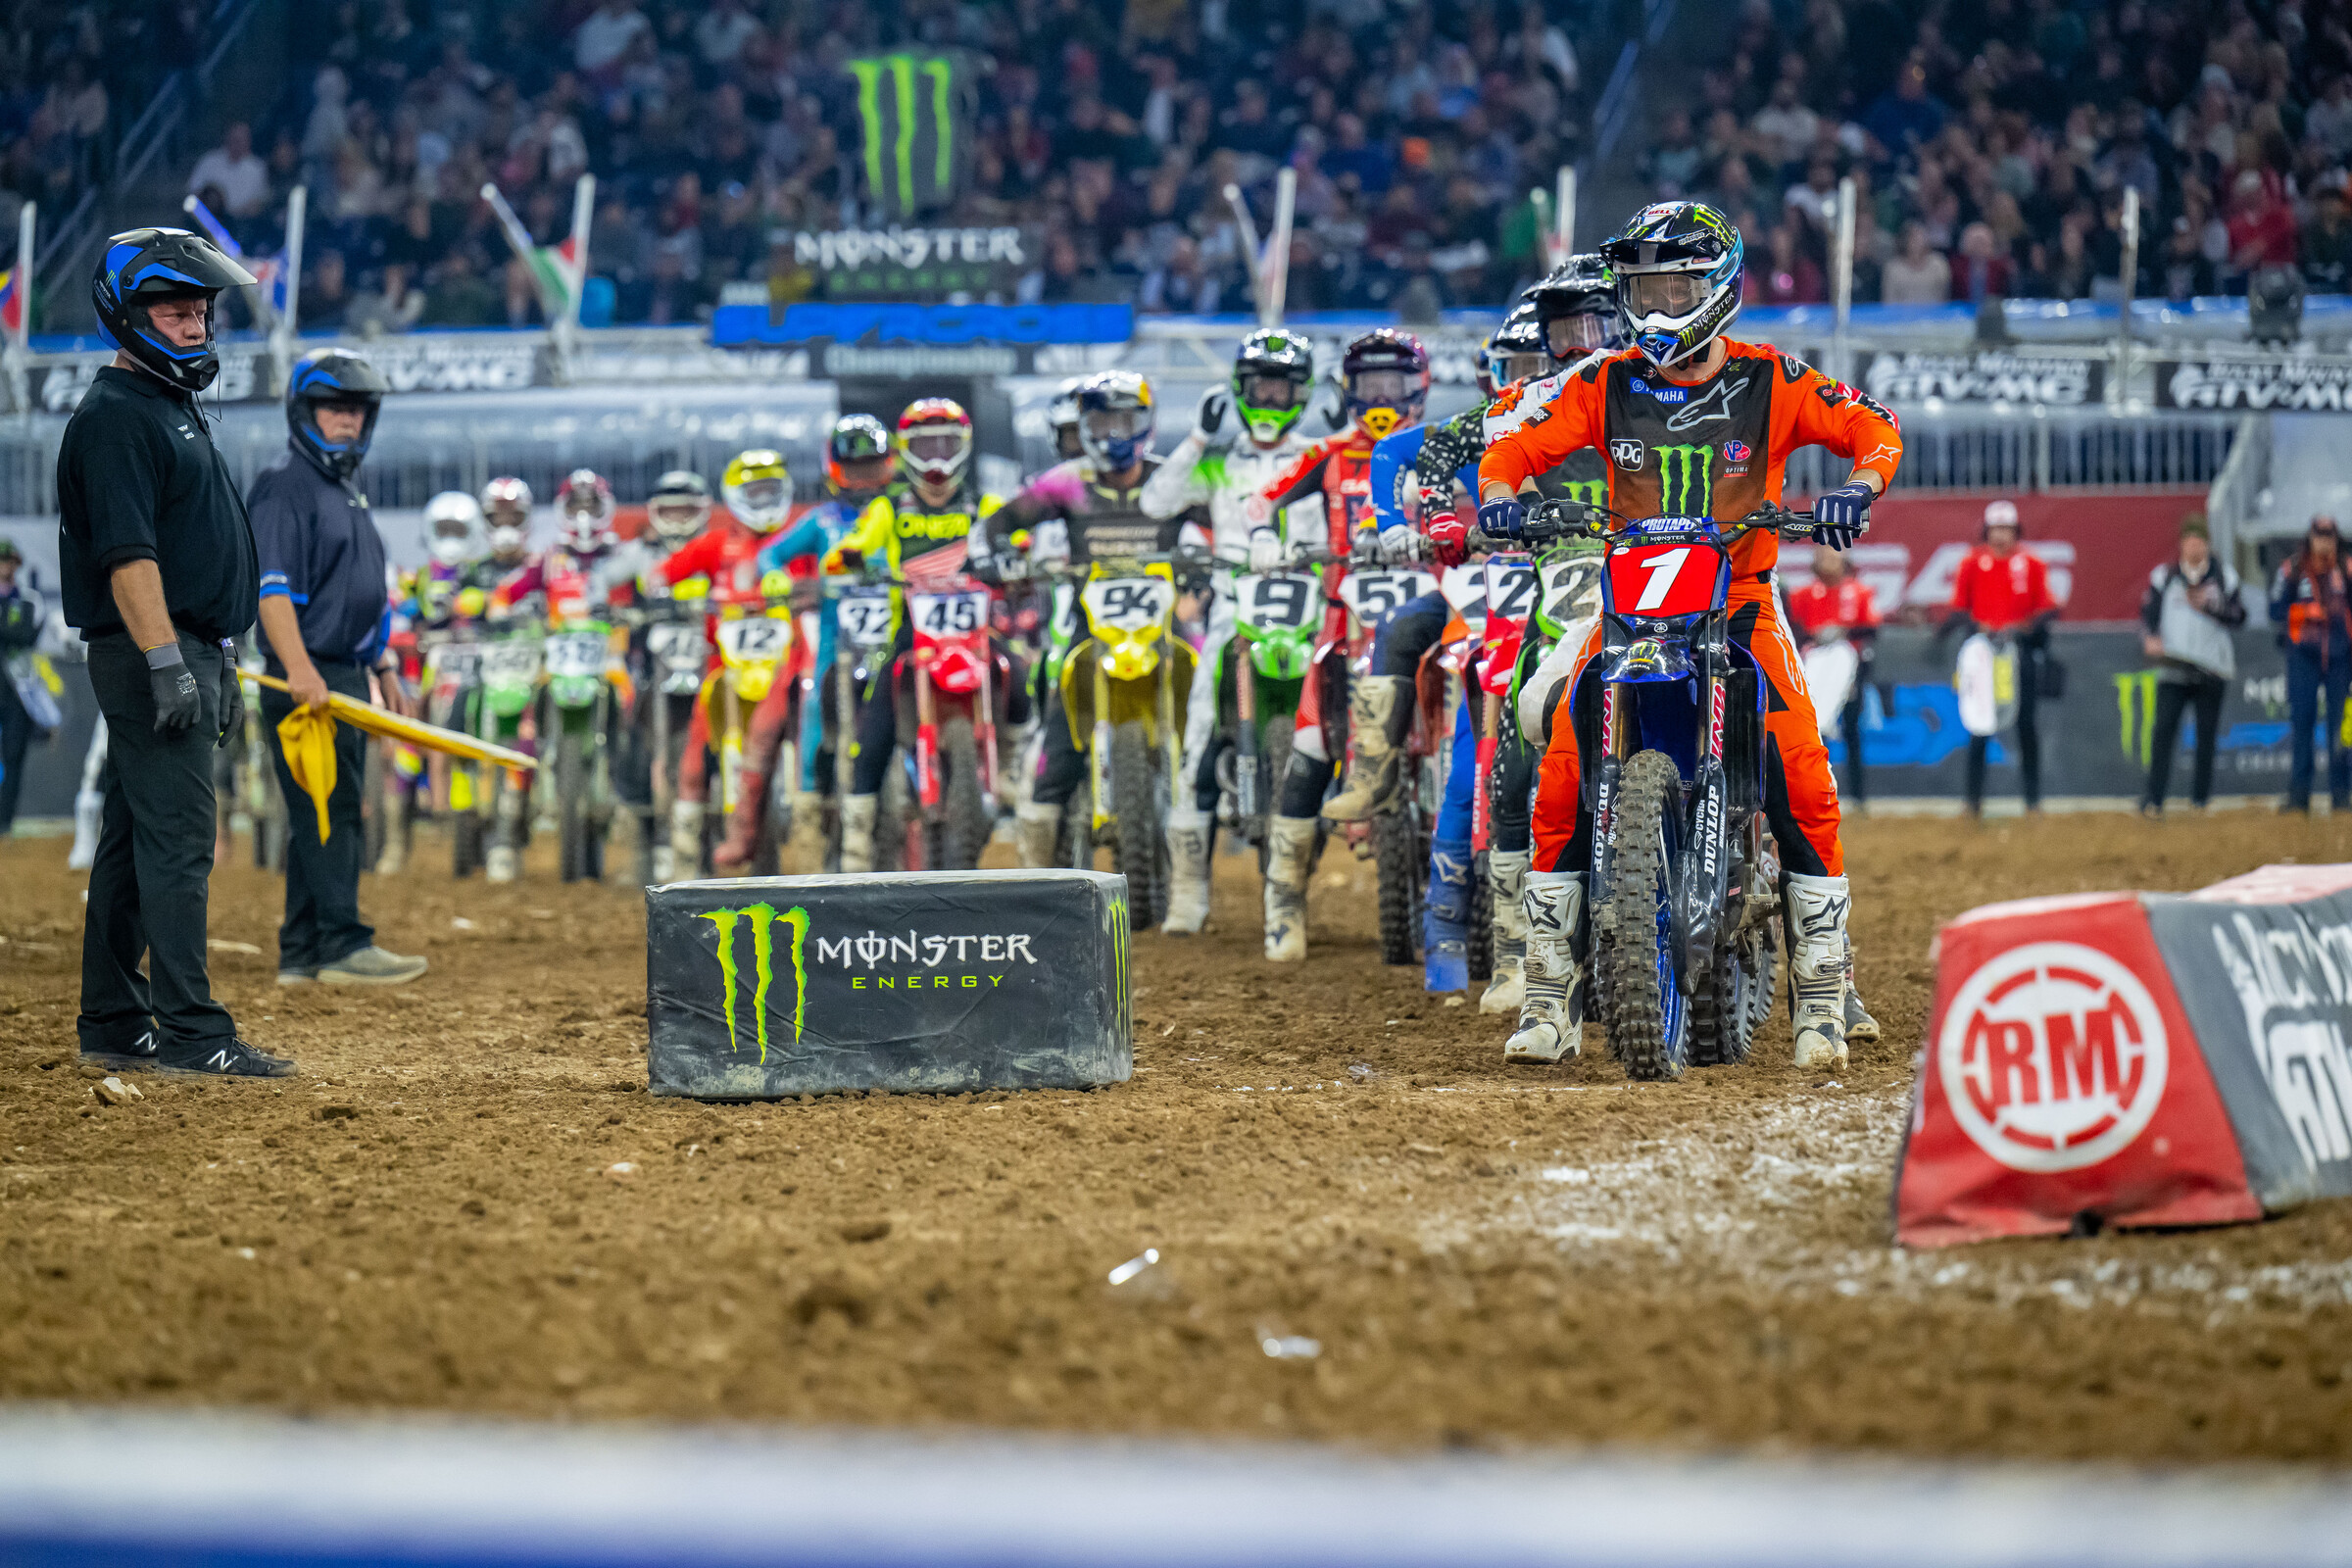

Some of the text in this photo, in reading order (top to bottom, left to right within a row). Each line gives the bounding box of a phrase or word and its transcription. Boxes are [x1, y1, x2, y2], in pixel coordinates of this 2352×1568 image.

[793, 224, 1026, 270] MONSTER
[1693, 291, 1735, 330] MONSTER
[1612, 442, 1642, 467] PPG
[1724, 441, 1742, 462] VP
[1784, 522, 1813, 532] ARC
[1547, 562, 1602, 622] 2
[1634, 547, 1692, 612] 1
[926, 602, 976, 631] 45
[1102, 585, 1159, 619] 94
[1253, 578, 1308, 626] 9
[1594, 782, 1609, 872] DUNLOP
[1695, 799, 1705, 831] CYCRA
[1703, 785, 1721, 877] DUNLOP
[815, 929, 1038, 969] MONSTER
[852, 974, 1004, 990] ENERGY
[1985, 1006, 2120, 1108] RM
